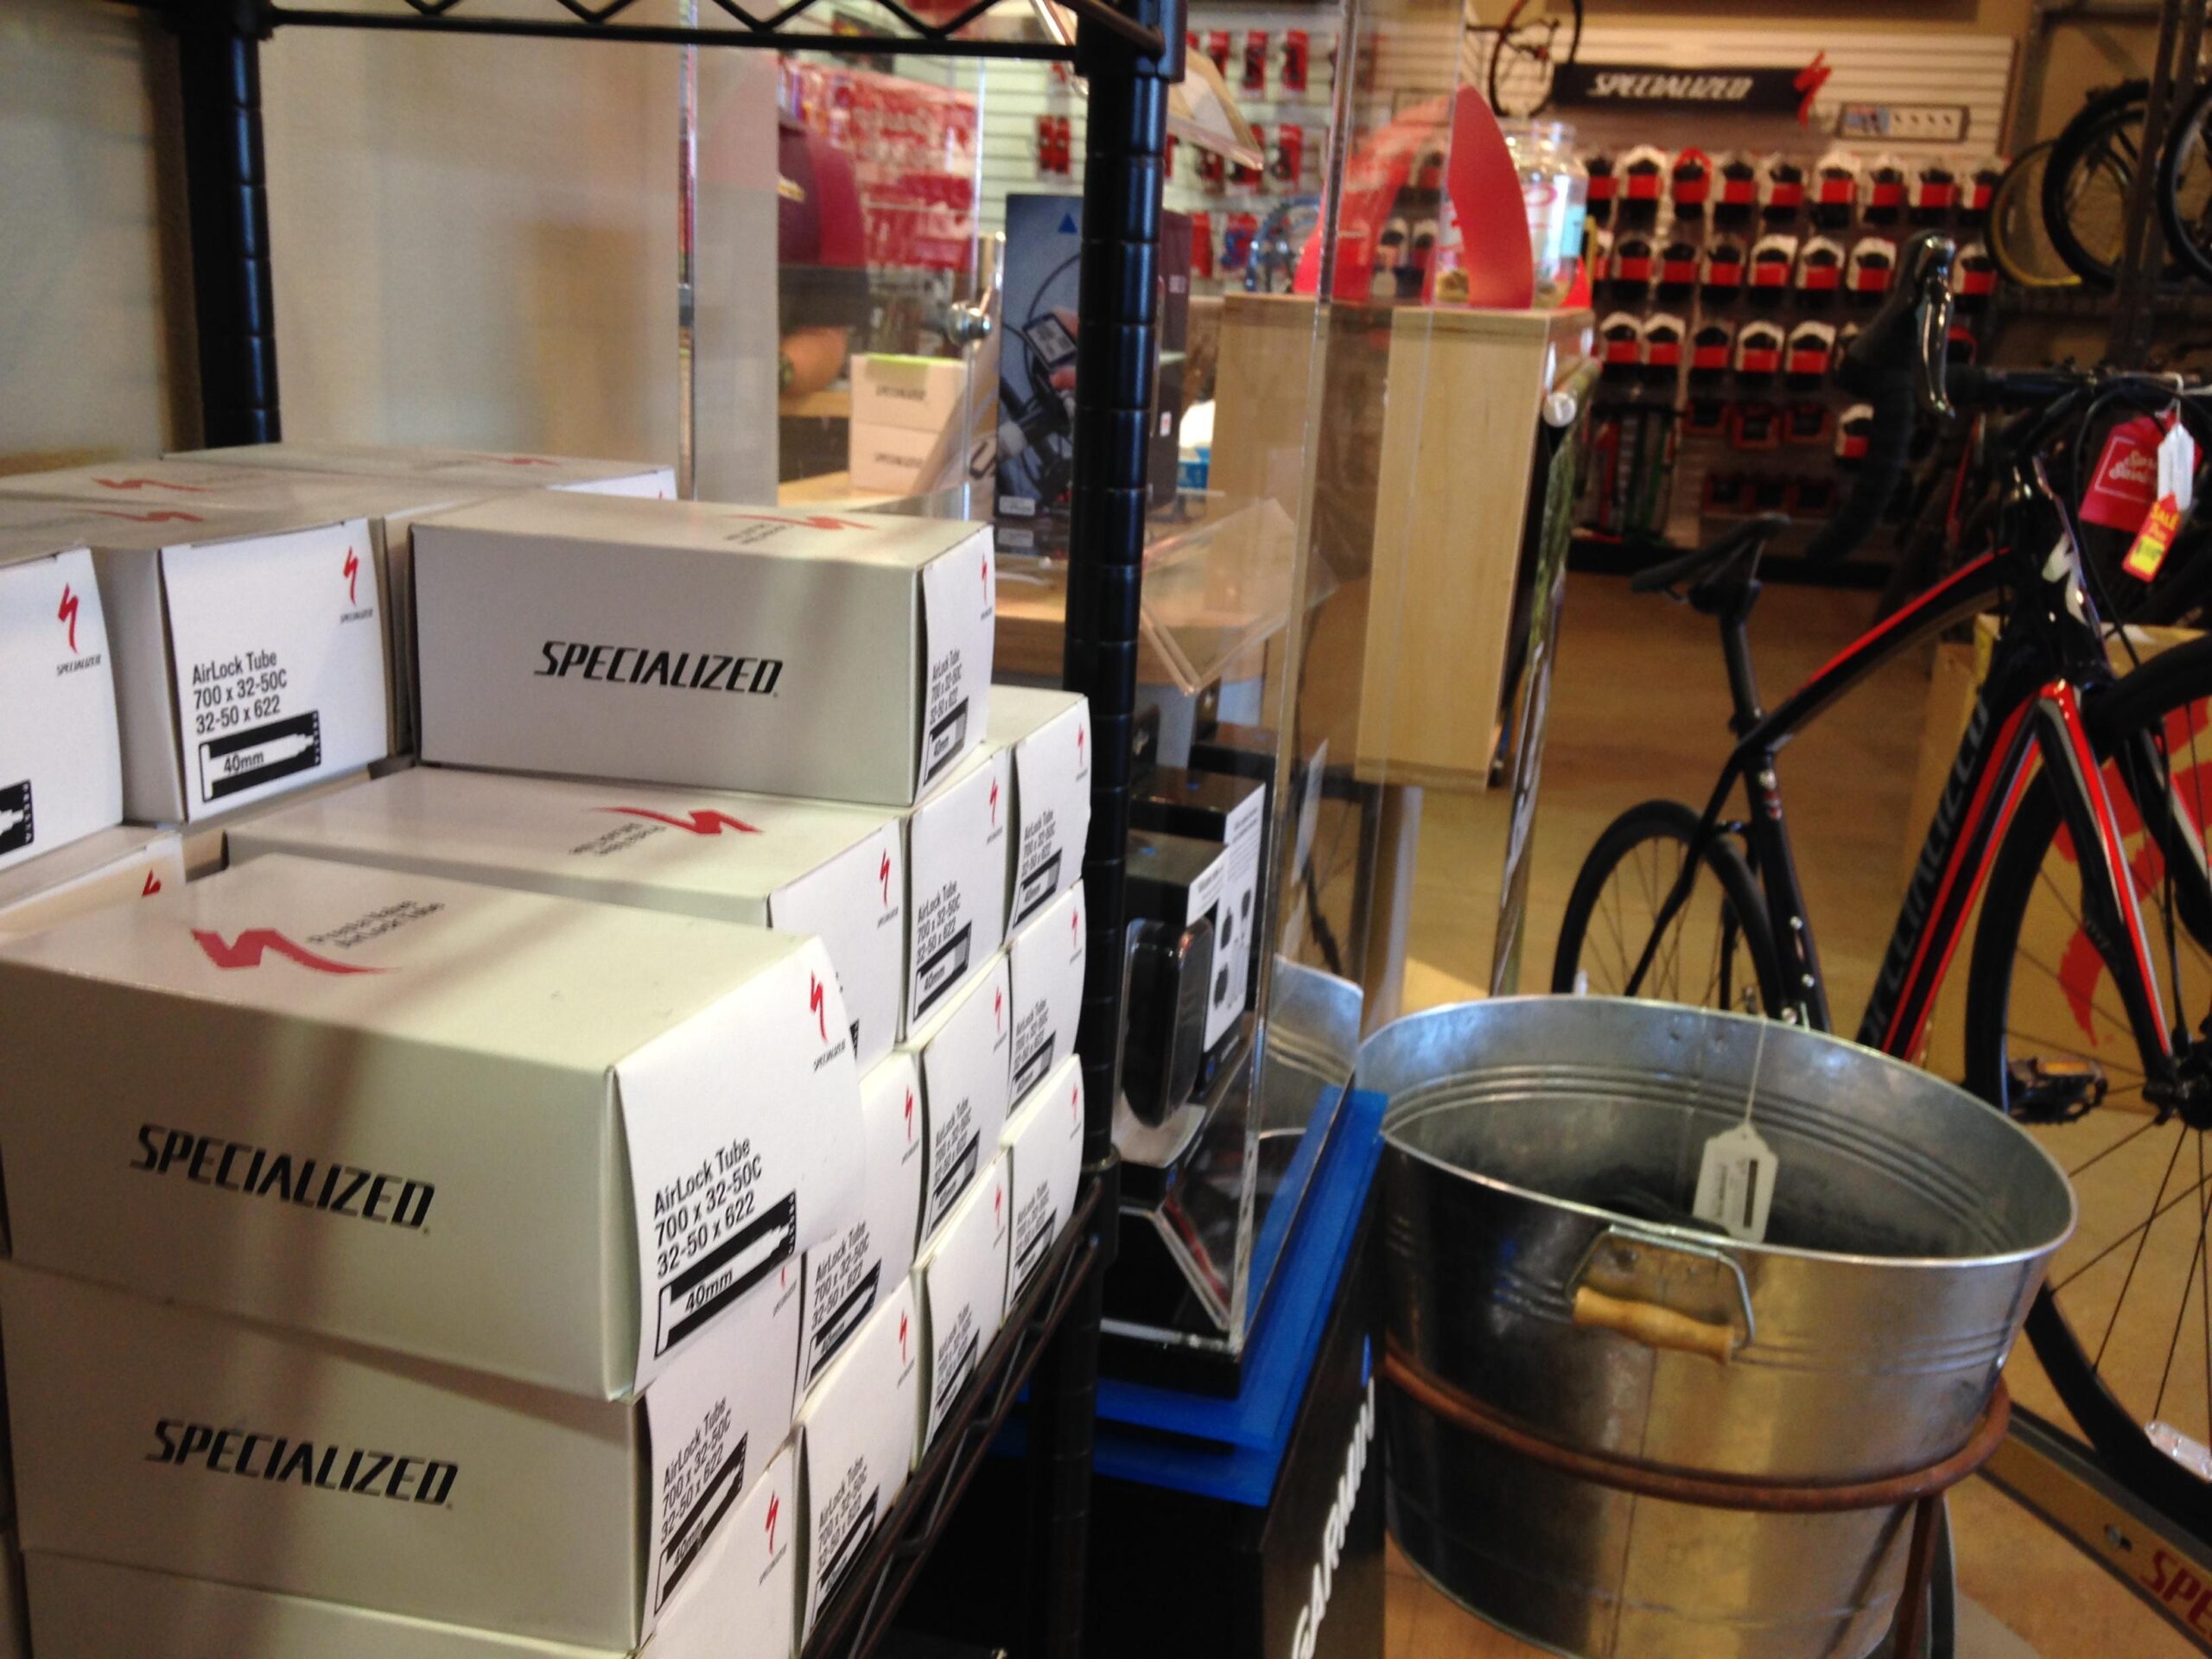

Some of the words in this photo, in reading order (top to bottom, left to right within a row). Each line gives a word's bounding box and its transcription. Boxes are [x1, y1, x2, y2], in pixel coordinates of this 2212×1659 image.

[1586, 72, 1753, 100] SPECIALIZED
[192, 655, 243, 685] AirLock
[246, 649, 277, 671] Tube
[194, 684, 221, 710] 700
[226, 687, 233, 702] x
[237, 669, 287, 698] 32-50C
[534, 640, 783, 695] SPECIALIZED
[196, 709, 239, 734] 32-50
[244, 707, 251, 722] x
[255, 695, 281, 718] 622
[224, 750, 264, 774] 40mm
[130, 1123, 435, 1230] SPECIALIZED
[654, 1159, 713, 1220] AirLock
[715, 1138, 750, 1173] Tube
[655, 1214, 689, 1249] 700
[694, 1202, 702, 1224] x
[706, 1154, 762, 1213] 32-50C
[658, 1223, 709, 1280] 32-50
[712, 1219, 721, 1242] x
[726, 1188, 755, 1230] 622
[816, 1238, 846, 1286] AirLock
[849, 1219, 866, 1249] Tube
[685, 1268, 734, 1313] 40mm
[811, 1286, 839, 1331] 32-50
[847, 1258, 863, 1292] 622
[814, 1273, 832, 1307] 700
[144, 1418, 459, 1505] SPECIALIZED
[663, 1427, 702, 1494] AirLock
[704, 1395, 726, 1435] Tube
[663, 1478, 683, 1518] 700
[686, 1468, 691, 1485] x
[694, 1408, 732, 1475] 32-50C
[661, 1485, 693, 1545] 32-50
[696, 1478, 701, 1497] x
[703, 1441, 724, 1484] 622
